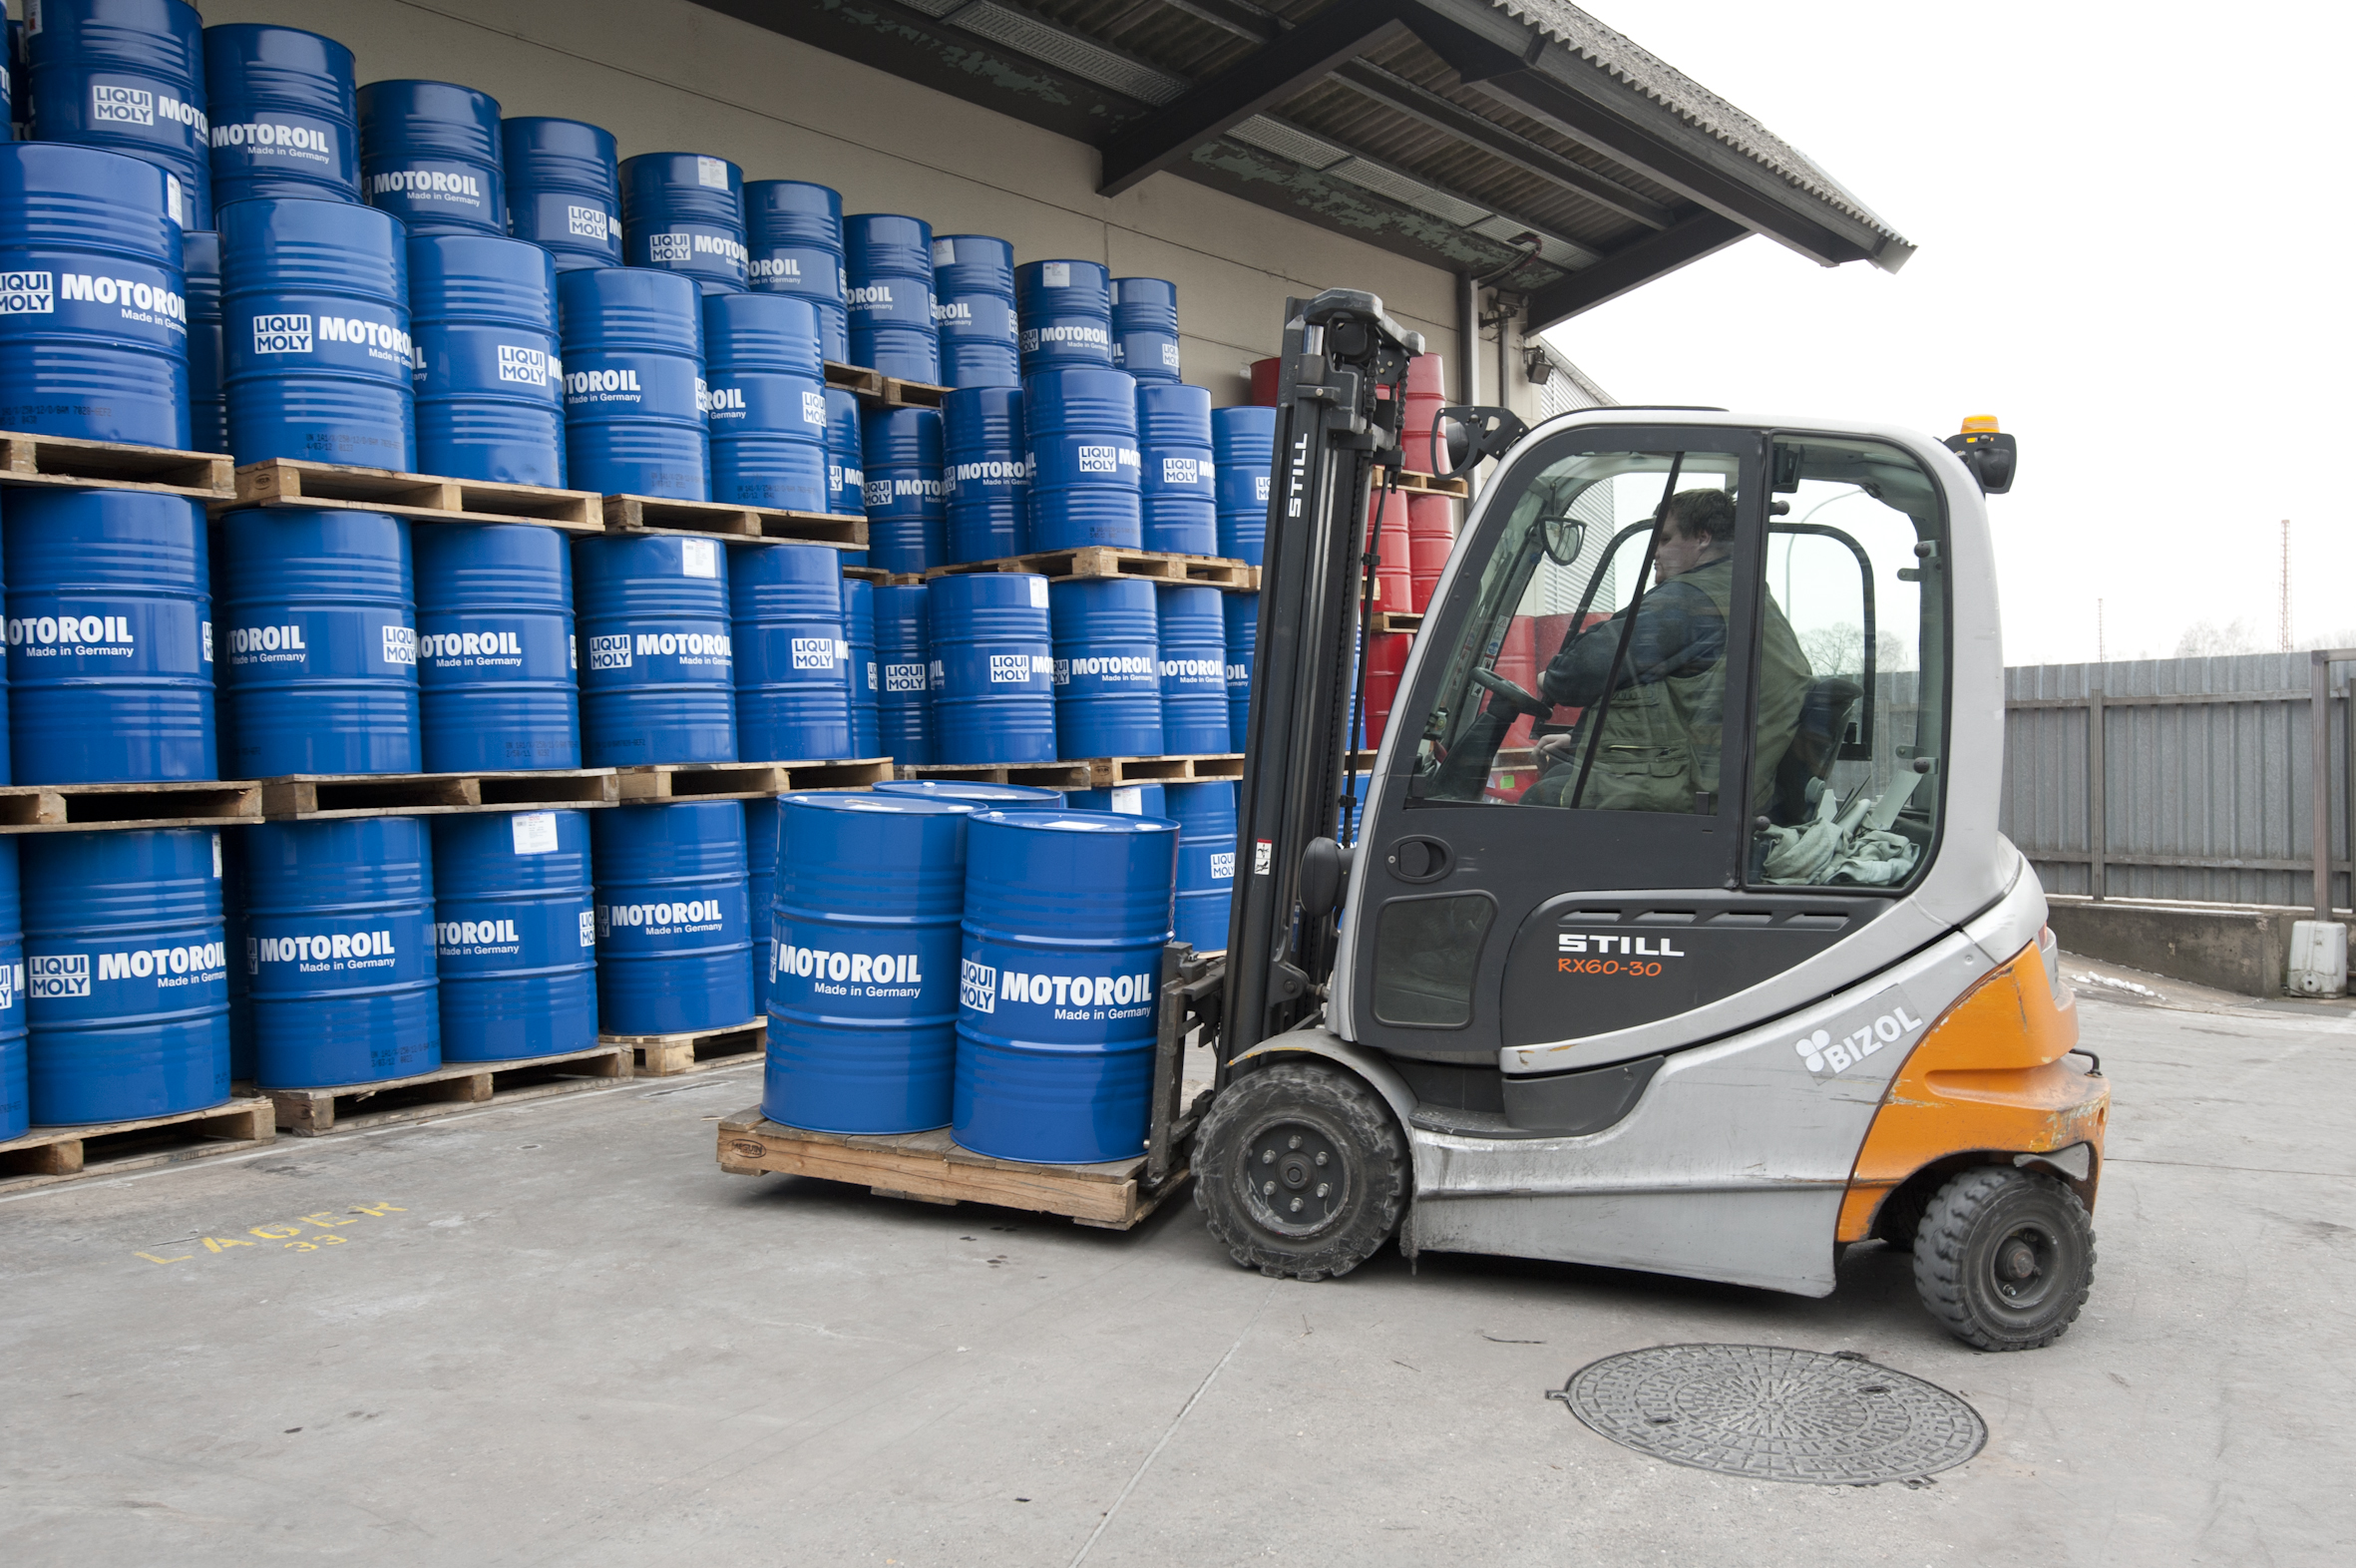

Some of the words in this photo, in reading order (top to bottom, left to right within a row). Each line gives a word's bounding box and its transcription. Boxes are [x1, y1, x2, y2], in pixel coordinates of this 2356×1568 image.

[96, 87, 150, 106] LIQUI
[97, 105, 152, 123] MOLY
[159, 96, 208, 140] MOTO
[212, 124, 329, 153] MOTOROIL
[247, 146, 274, 155] Made
[277, 147, 286, 156] in
[289, 148, 329, 164] Germany
[374, 171, 480, 196] MOTOROIL
[407, 192, 431, 200] Made
[444, 194, 480, 207] Germany
[571, 208, 605, 224] LIQUI
[572, 221, 606, 238] MOLY
[651, 235, 688, 248] LIQUI
[695, 235, 748, 263] MOTOR
[652, 248, 690, 260] MOLY
[749, 258, 800, 277] OROIL
[0, 273, 48, 291] IQUI
[749, 276, 760, 285] ade
[770, 275, 801, 285] Germany
[62, 273, 187, 324] MOTOROIL
[848, 286, 893, 303] OROIL
[864, 302, 893, 311] Germany
[938, 303, 972, 319] ROIL
[121, 308, 153, 323] Made
[155, 315, 164, 325] in
[256, 316, 307, 333] LIQUI
[945, 319, 972, 328] Germany
[257, 334, 310, 352] MOLY
[1040, 326, 1108, 344] MOTOROIL
[369, 348, 393, 361] Made
[502, 348, 544, 367] LIQUI
[1165, 356, 1179, 365] MOL
[502, 366, 545, 384] MOLY
[563, 370, 640, 396] TOROIL
[569, 394, 589, 404] Made
[599, 393, 641, 404] Germany
[707, 388, 745, 409] ROIL
[710, 411, 746, 420] Germany
[1081, 448, 1114, 460] LIQUI
[958, 461, 1024, 480] MOTORO
[1082, 460, 1115, 471] MOLY
[1165, 460, 1195, 471] LIQUI
[1166, 473, 1196, 483] MOLY
[1289, 433, 1308, 518] STILL
[896, 480, 943, 496] MOTO
[226, 625, 305, 654] TOROIL
[590, 636, 627, 652] LIQUI
[636, 633, 732, 656] MOTOROIL
[795, 639, 831, 653] LIQUI
[26, 647, 57, 657] Made
[60, 646, 71, 656] in
[75, 645, 134, 658] Germany
[231, 654, 248, 665] Made
[249, 654, 257, 663] in
[259, 652, 306, 663] Germany
[591, 652, 629, 668] MOLY
[436, 658, 462, 667] Made
[464, 657, 474, 666] in
[476, 656, 522, 667] Germany
[679, 656, 703, 665] Made
[704, 656, 711, 665] in
[796, 654, 832, 667] MOLY
[992, 656, 1027, 668] LIQUI
[1072, 656, 1152, 675] MOTOROIL
[888, 665, 924, 677] LIQUI
[993, 669, 1028, 680] MOLY
[1130, 674, 1153, 683] Germany
[889, 678, 924, 690] MOLY
[612, 900, 722, 927] MOTOROIL
[435, 920, 519, 946] TOROIL
[645, 927, 671, 936] Made
[684, 923, 723, 934] Germany
[260, 931, 395, 962] MOTOROIL
[440, 947, 461, 956] Made
[474, 945, 520, 955] Germany
[1558, 934, 1685, 957] STILL
[31, 957, 86, 976] LIQUI
[99, 942, 225, 980] MOTOROIL
[300, 962, 330, 973] Made
[333, 961, 344, 971] in
[347, 958, 395, 971] Germany
[778, 944, 922, 983] MOTOROIL
[1557, 958, 1662, 977] RX60-30
[158, 977, 189, 987] Made
[191, 975, 199, 984] in
[963, 959, 992, 987] LIQUI
[32, 977, 88, 995] MOLY
[814, 982, 847, 995] Made
[851, 985, 862, 996] in
[866, 986, 921, 998] Germany
[1000, 971, 1152, 1006] MOTOROIL
[961, 985, 993, 1010] MOLY
[1054, 1008, 1089, 1019] Made
[1094, 1009, 1104, 1019] in
[1108, 1006, 1151, 1020] Germany
[1823, 1006, 1923, 1073] BIZOL
[134, 1202, 408, 1264] LAGER
[284, 1234, 348, 1252] 33
